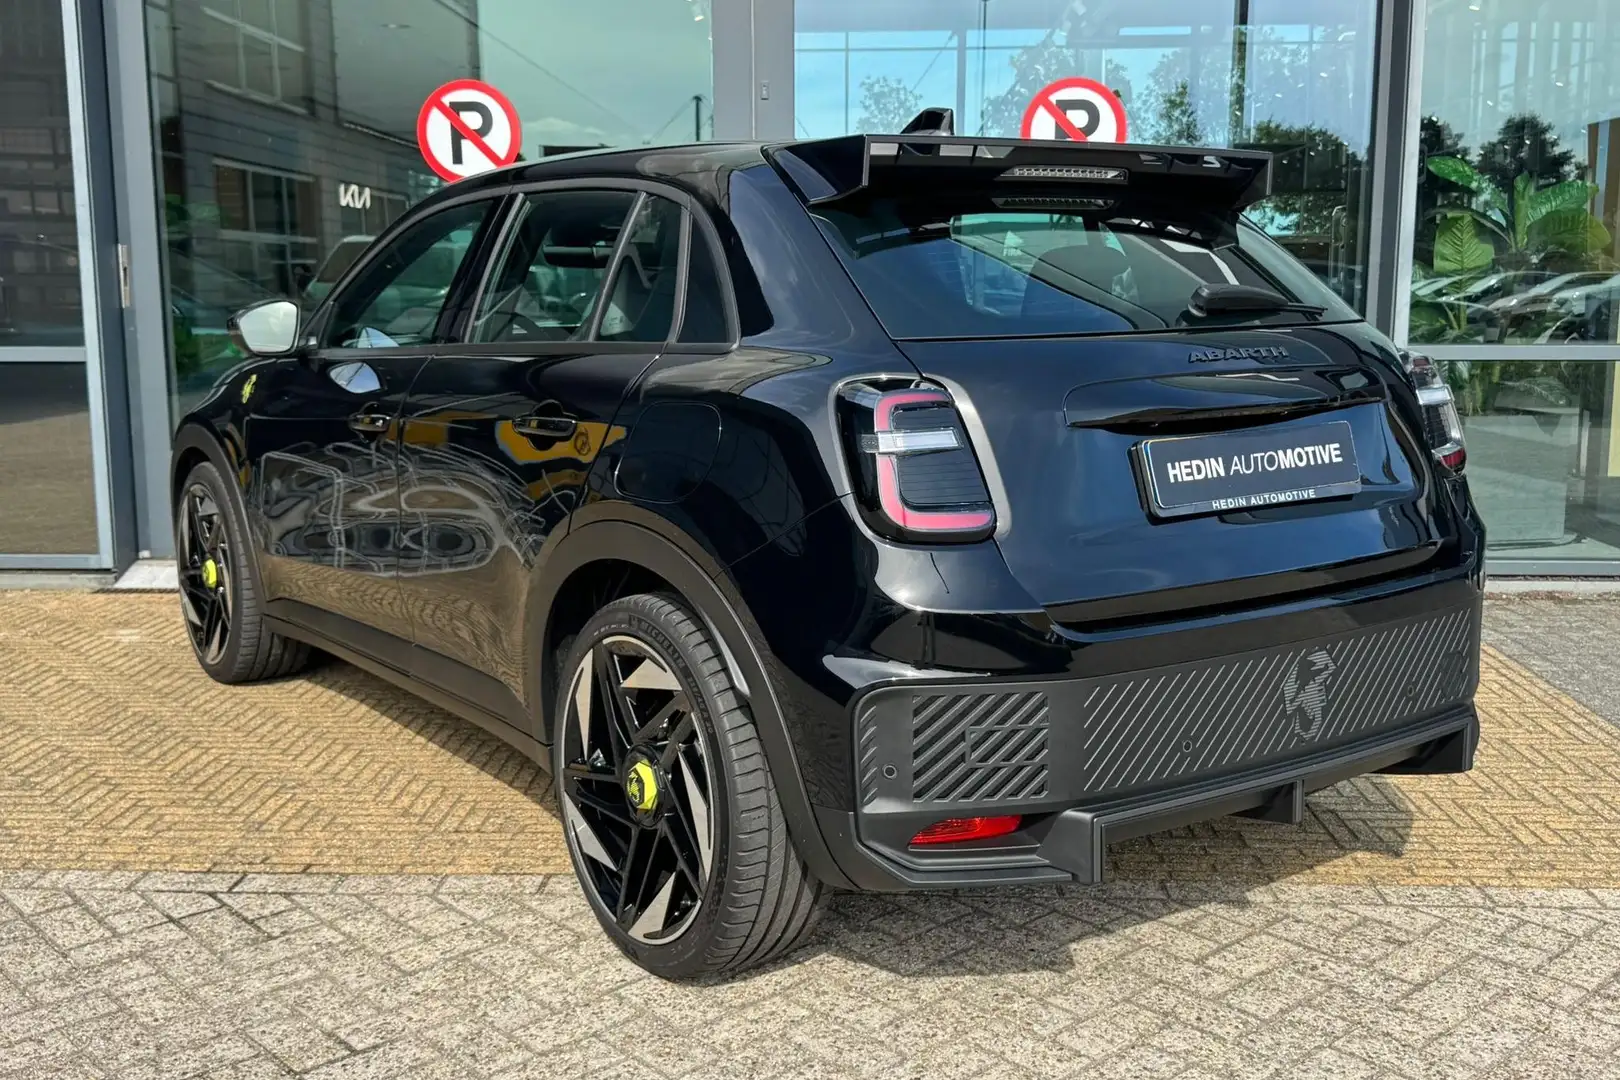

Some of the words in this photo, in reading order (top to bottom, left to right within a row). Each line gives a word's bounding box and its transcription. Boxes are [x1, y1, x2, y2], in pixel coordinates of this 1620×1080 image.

[449, 101, 493, 165] P
[1188, 346, 1289, 363] ABARTH
[1167, 457, 1226, 483] HEDIN
[1230, 443, 1343, 476] AUTOMOTIVE
[1212, 498, 1246, 510] HEDIN
[1250, 488, 1316, 506] AUTOMOTIVE
[639, 619, 686, 669] MICHELIN
